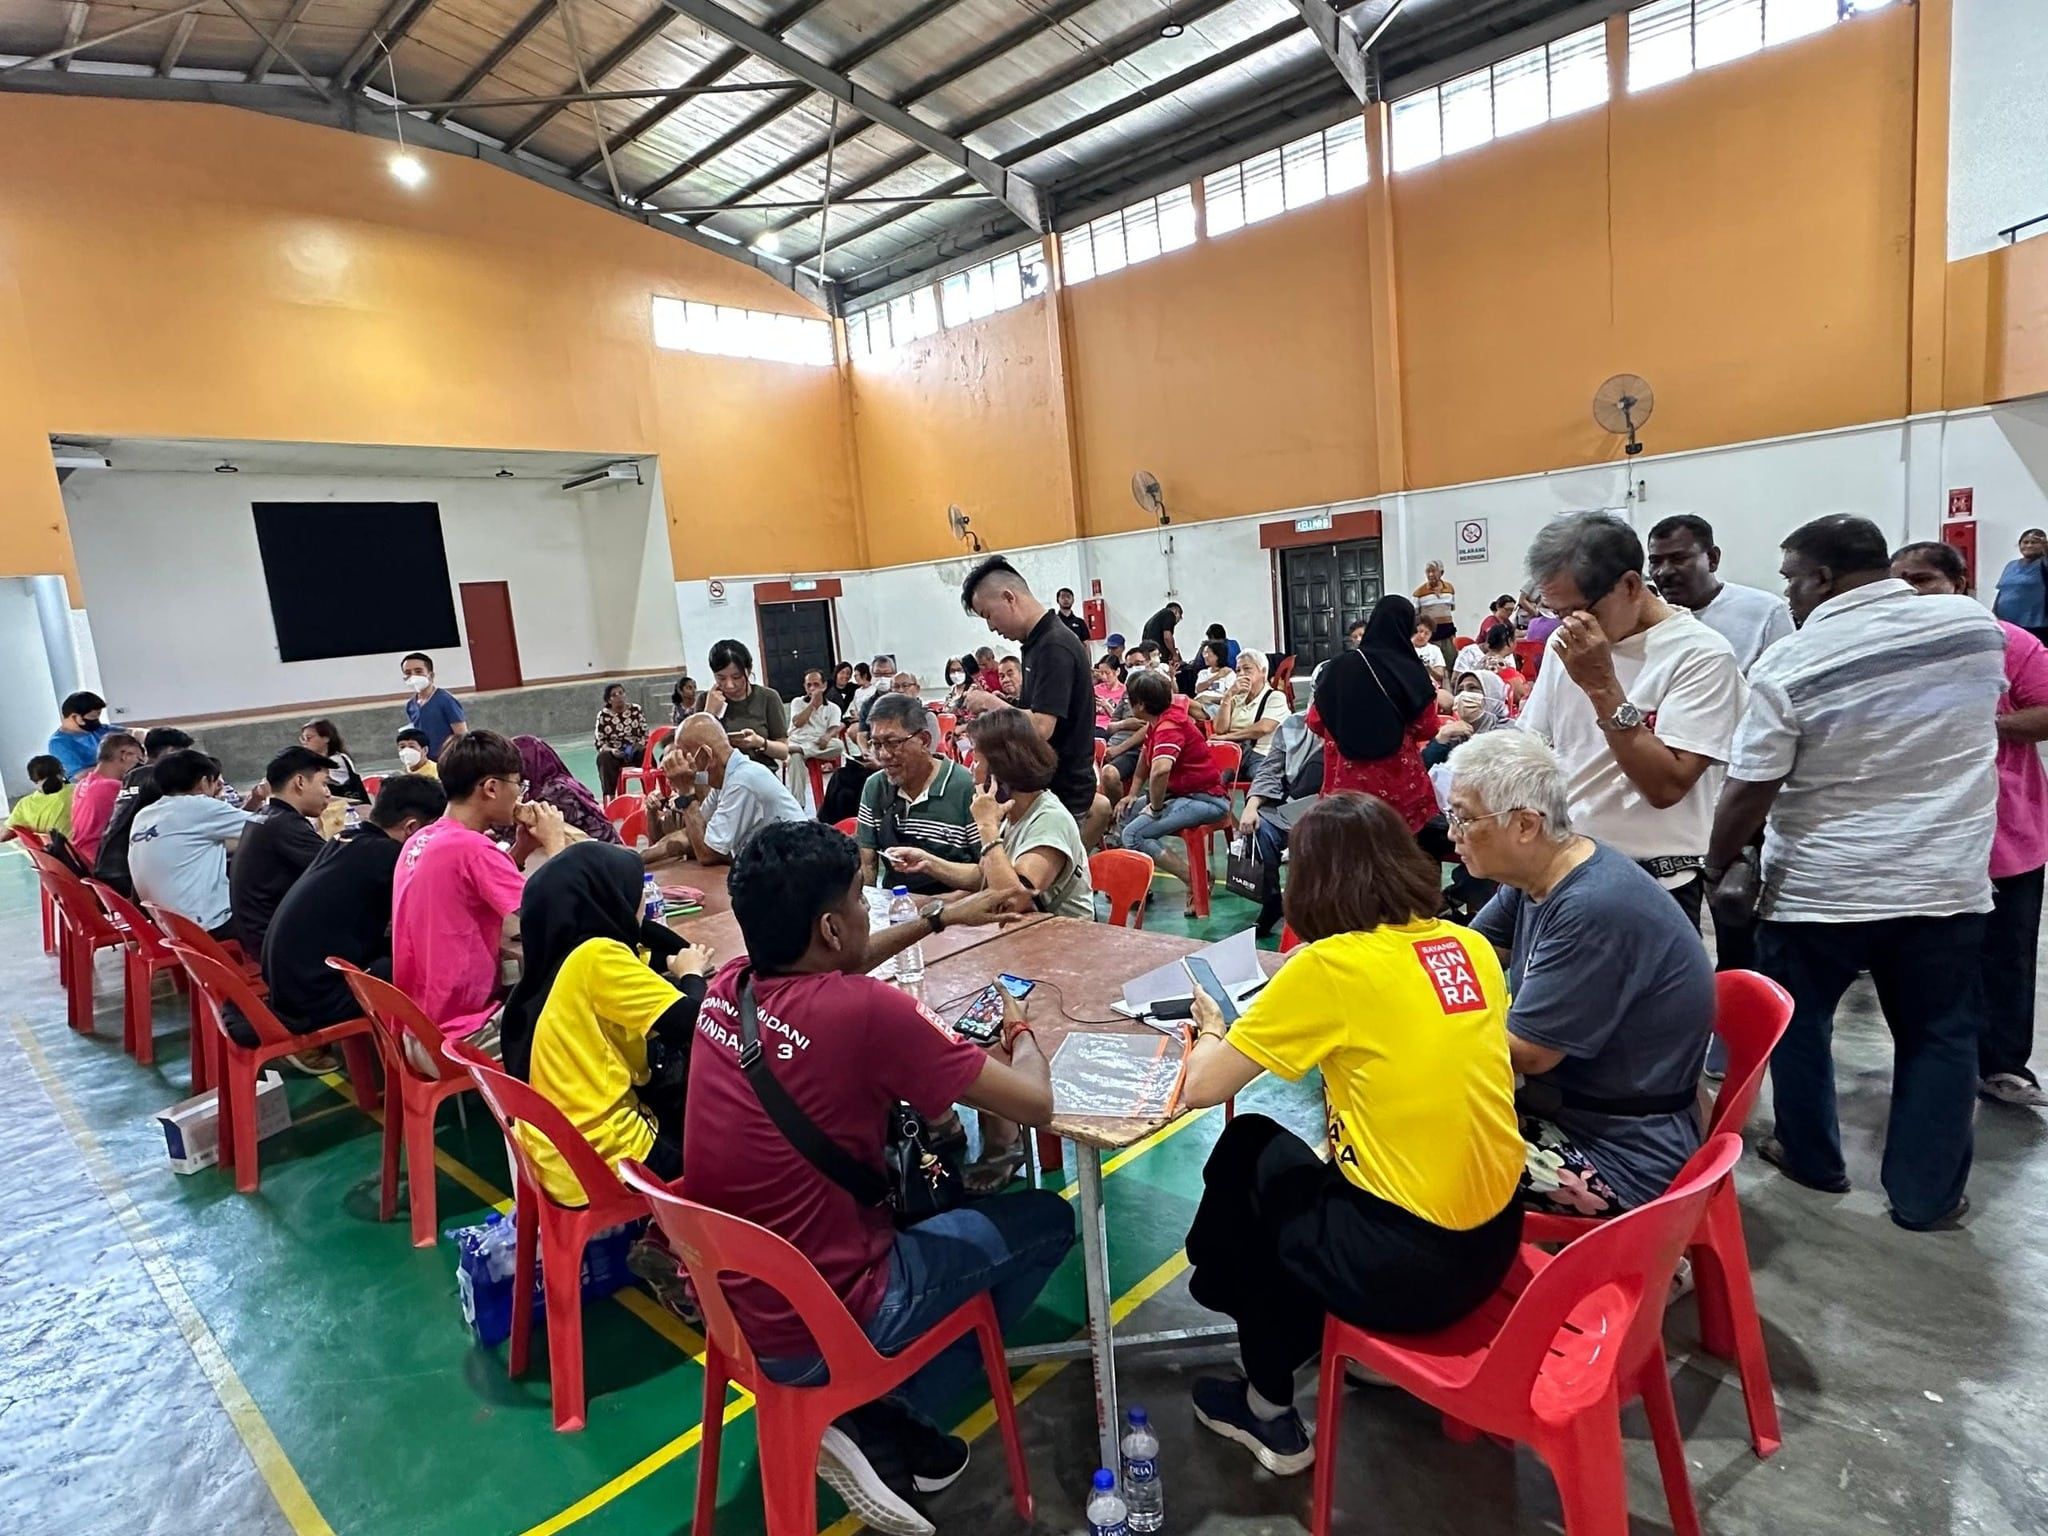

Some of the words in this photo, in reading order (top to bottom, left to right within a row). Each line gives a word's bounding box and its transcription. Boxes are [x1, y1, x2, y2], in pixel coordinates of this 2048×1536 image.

[1426, 950, 1466, 969] KIN
[1435, 966, 1473, 987] RA
[1442, 984, 1480, 1006] RA
[777, 1043, 793, 1060] 3
